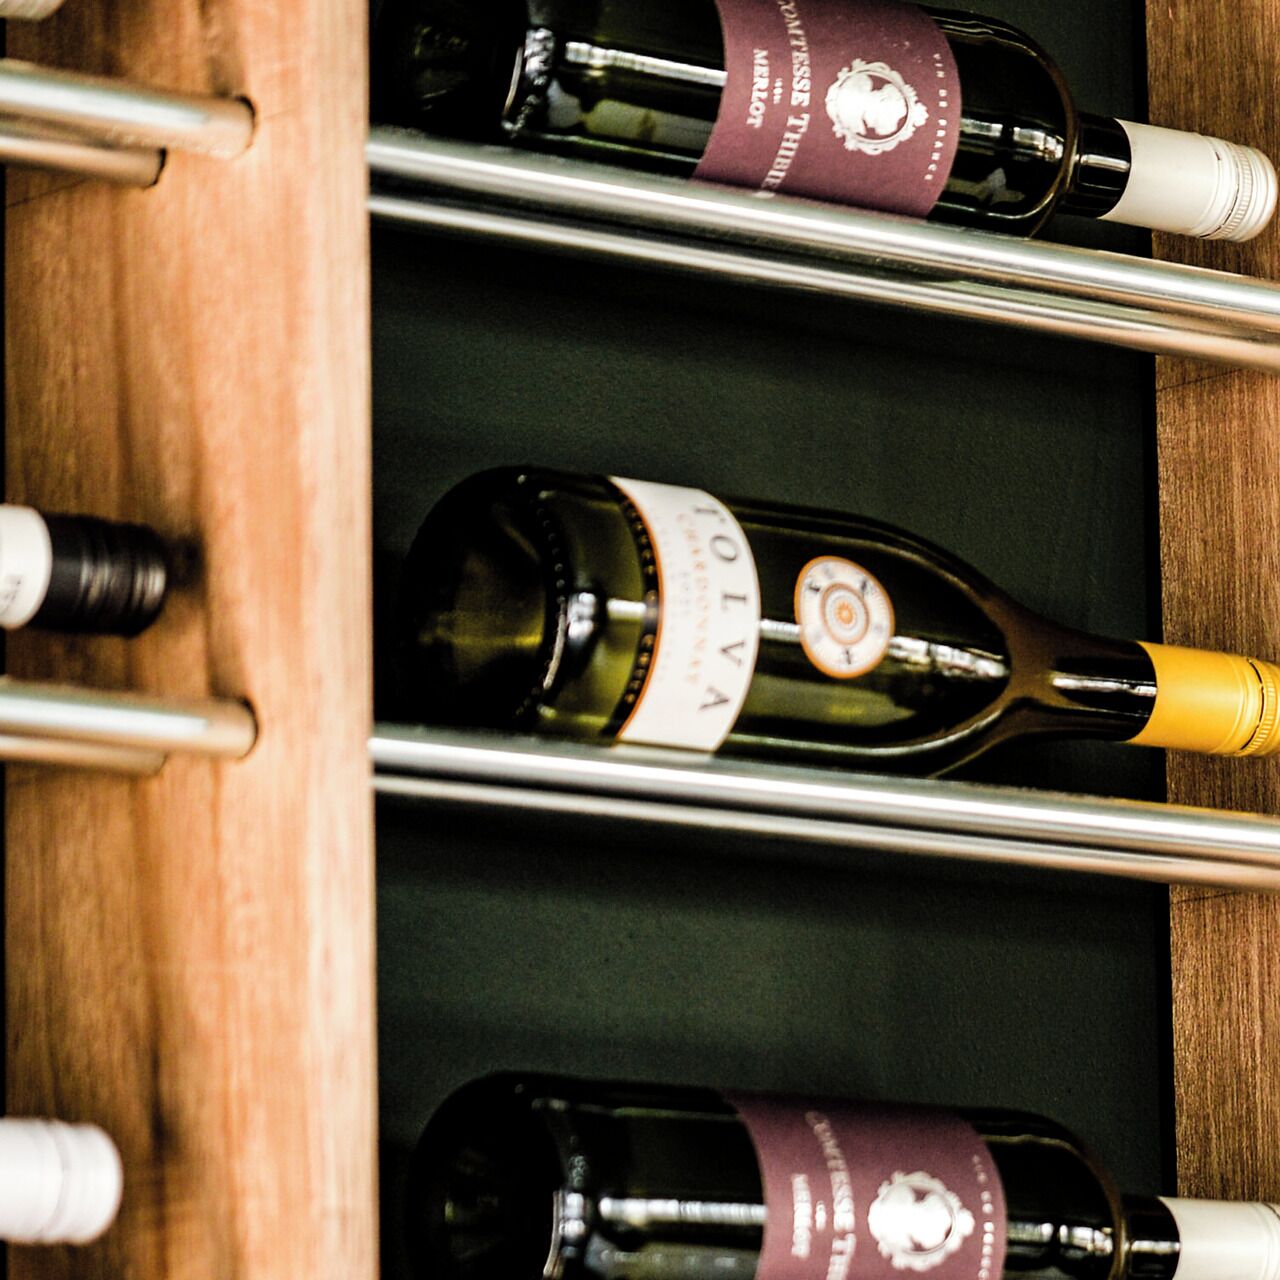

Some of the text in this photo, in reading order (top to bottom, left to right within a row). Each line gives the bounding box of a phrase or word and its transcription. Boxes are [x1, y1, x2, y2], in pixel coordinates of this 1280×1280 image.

[745, 48, 770, 130] MERLOT
[757, 112, 812, 196] THIBIE
[693, 504, 749, 712] TOLVA
